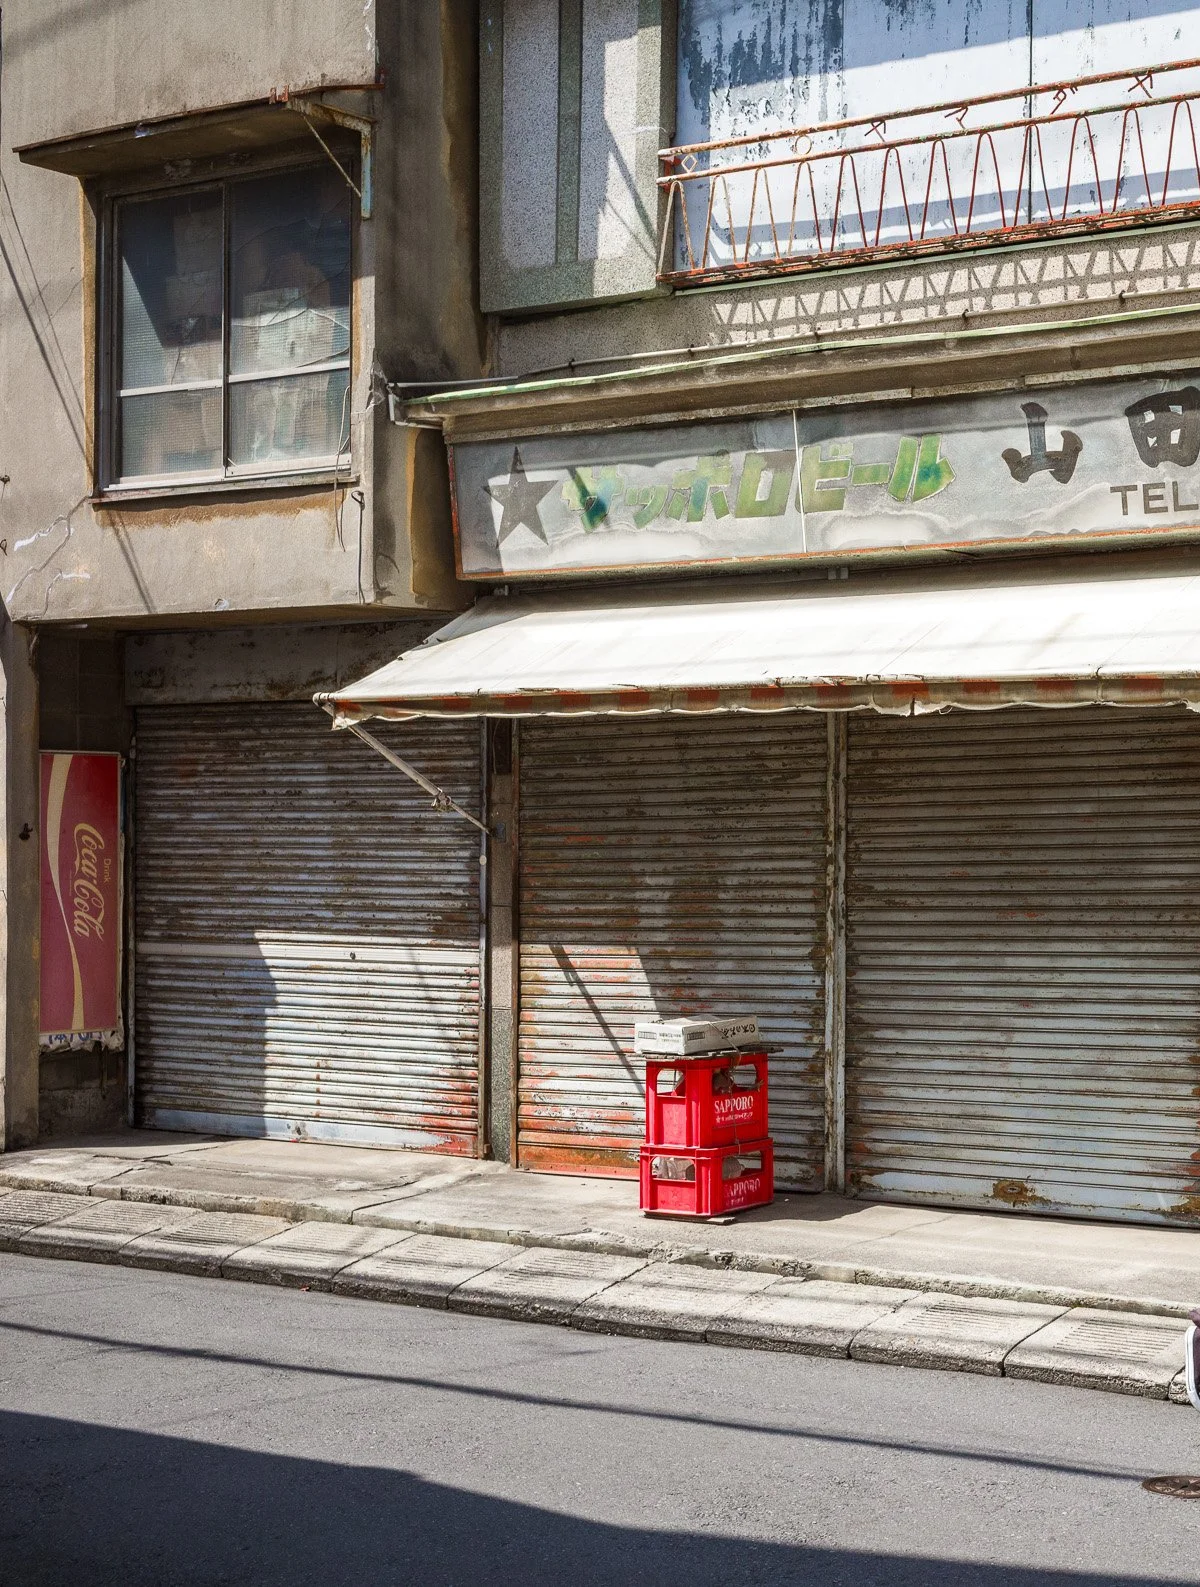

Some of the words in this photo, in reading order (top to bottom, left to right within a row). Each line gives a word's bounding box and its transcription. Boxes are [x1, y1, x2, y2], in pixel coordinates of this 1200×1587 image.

[561, 432, 957, 534] サッポロビール
[1109, 480, 1200, 516] TEL
[103, 858, 112, 883] Drink
[714, 1095, 754, 1114] SAPPORO
